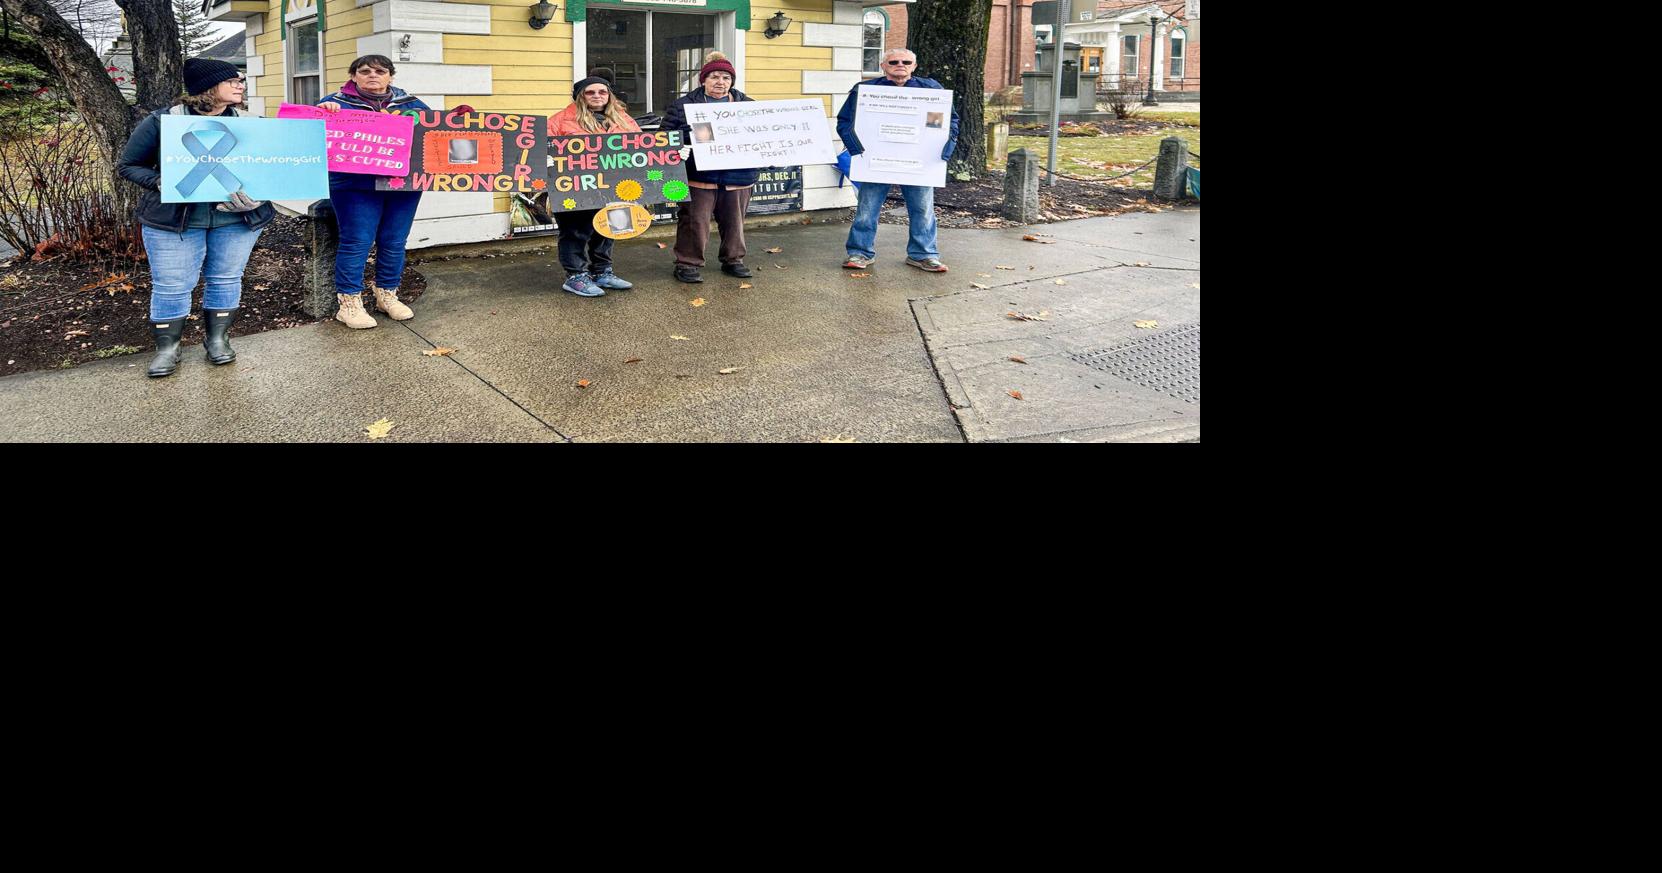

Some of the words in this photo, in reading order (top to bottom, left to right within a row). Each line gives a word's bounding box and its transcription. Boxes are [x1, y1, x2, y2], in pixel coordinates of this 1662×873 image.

[446, 111, 536, 133] CHOSE
[717, 125, 740, 136] SHE
[607, 131, 680, 151] CHOSE
[709, 143, 733, 155] HER
[737, 140, 773, 152] FIGHT
[777, 139, 794, 149] IS
[377, 146, 395, 157] BE
[553, 153, 599, 173] THE
[600, 149, 681, 170] WRONG
[412, 172, 513, 191] WRONG
[555, 172, 609, 192] GIRL
[774, 171, 791, 181] DEC.
[754, 182, 786, 193] ITUTE
